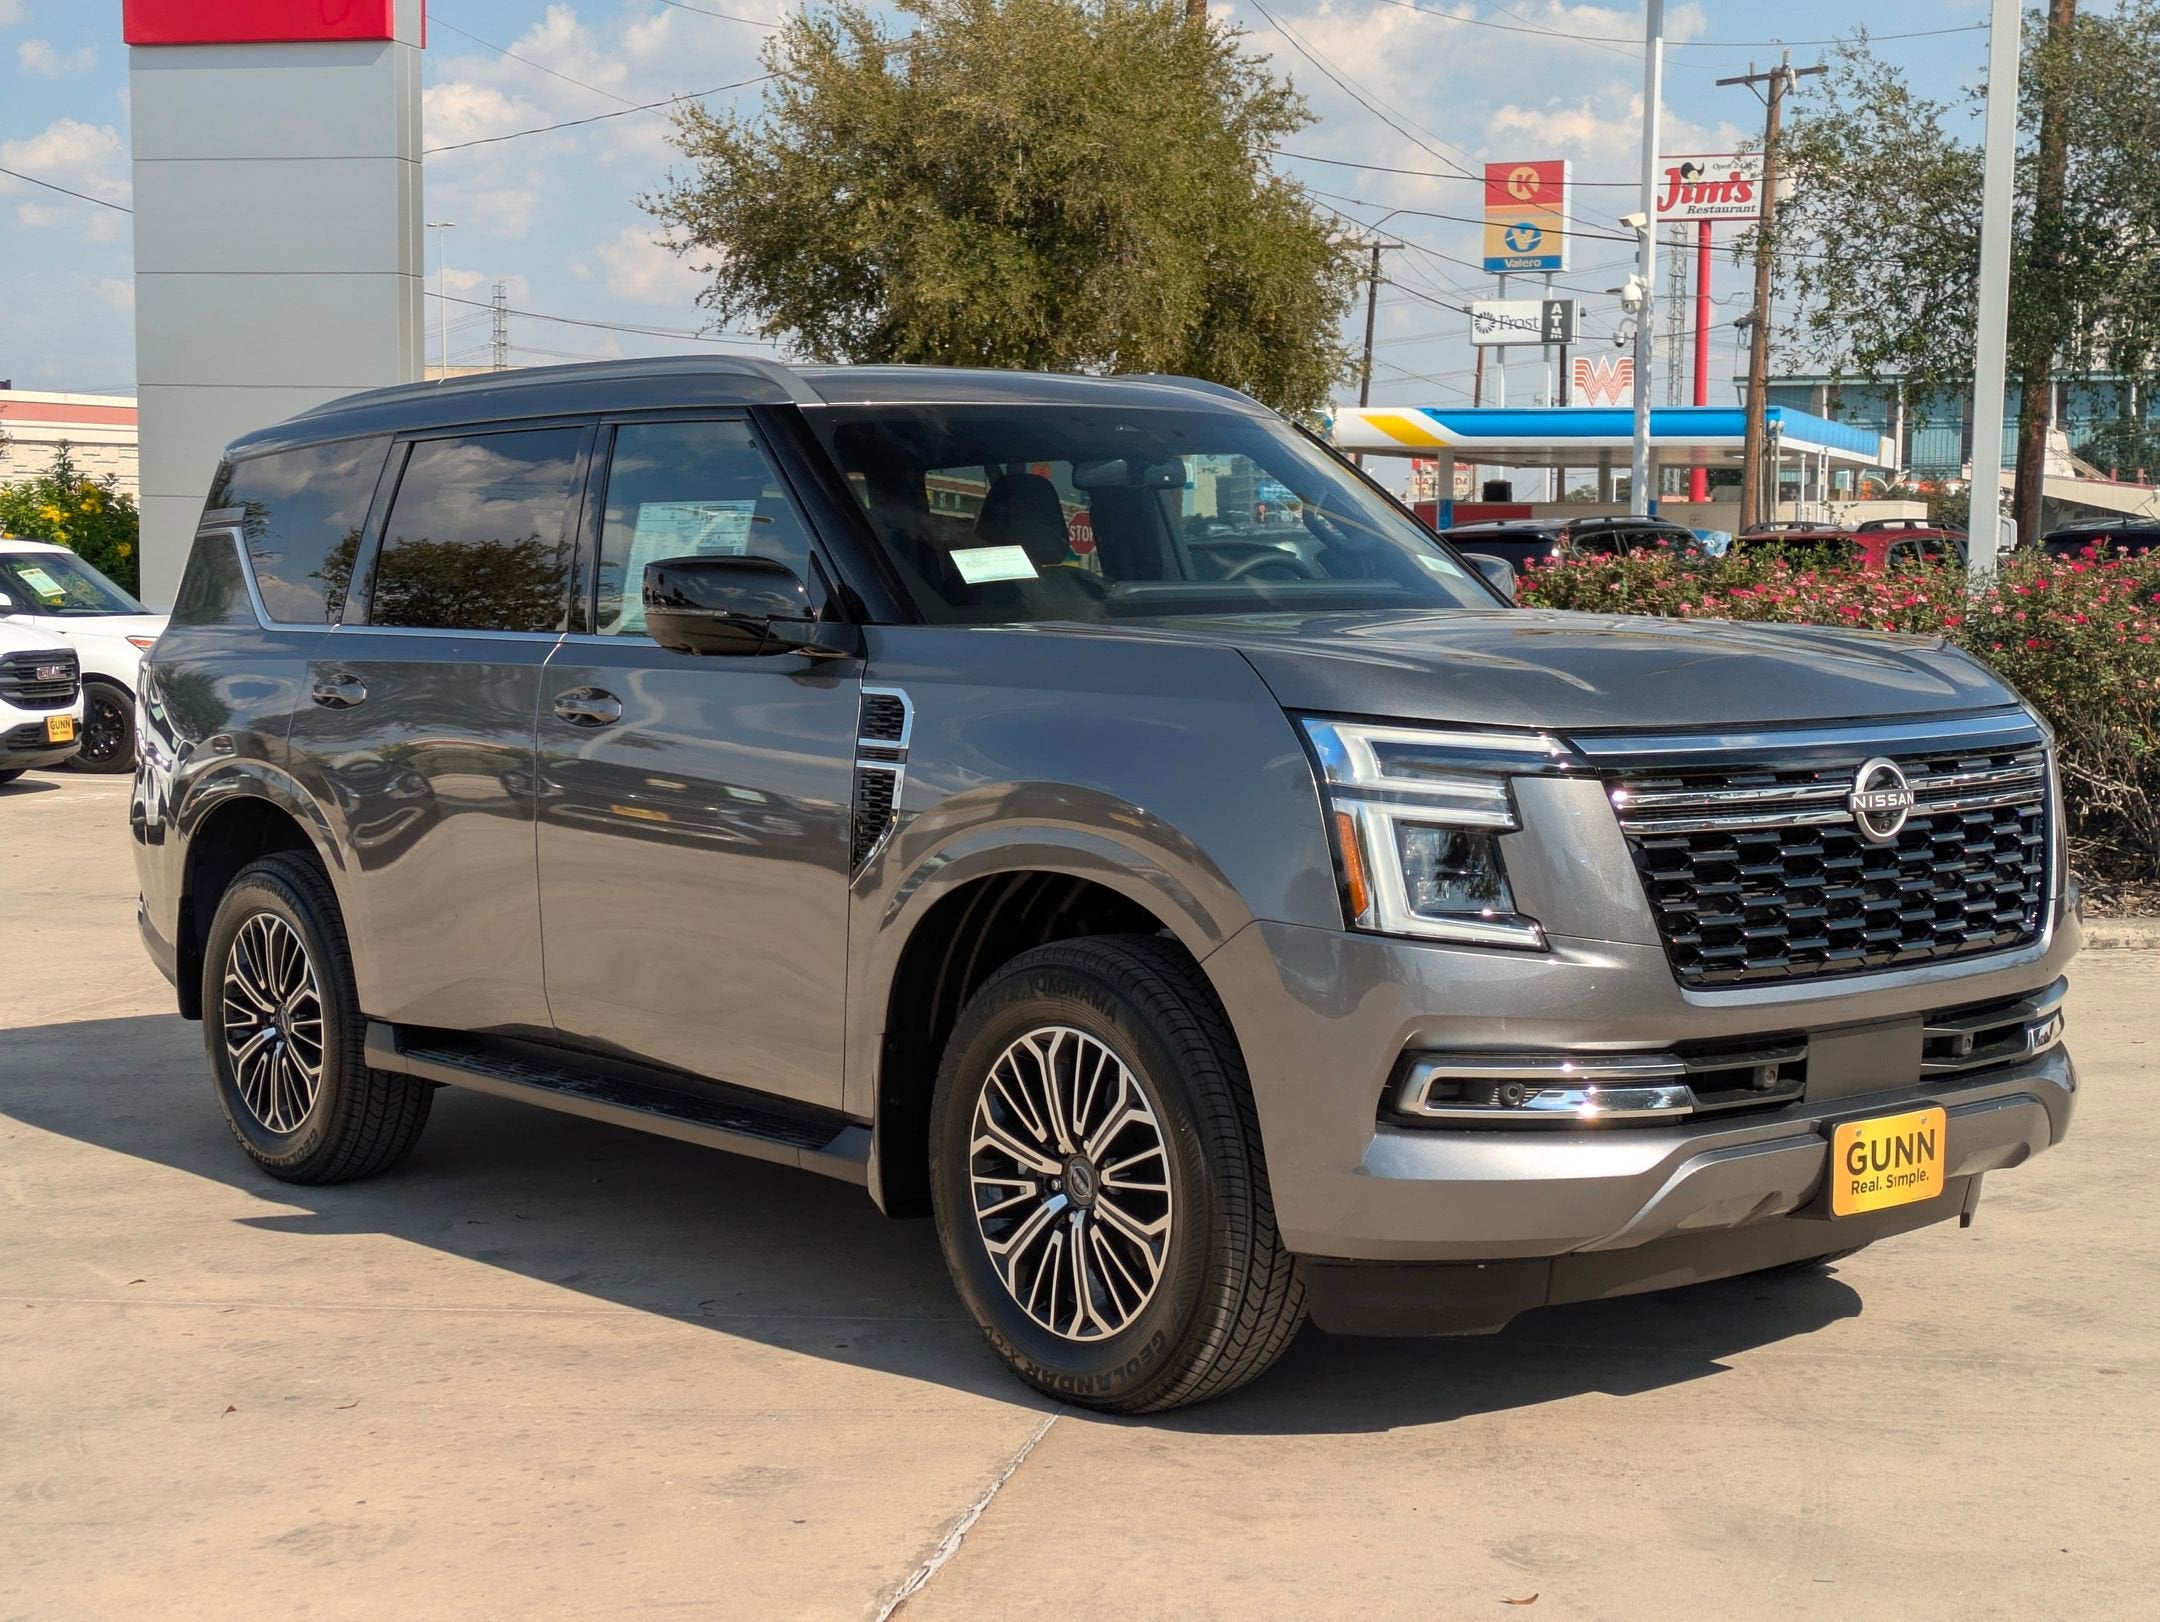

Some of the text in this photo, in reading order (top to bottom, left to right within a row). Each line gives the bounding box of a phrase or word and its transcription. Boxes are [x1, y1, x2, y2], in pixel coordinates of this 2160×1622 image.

[1657, 167, 1754, 212] Jim's
[1687, 205, 1756, 214] Restaurant
[1504, 258, 1542, 268] Valero
[1499, 314, 1540, 330] Frost
[1550, 302, 1563, 339] ATM
[50, 720, 70, 730] GUNN
[1853, 791, 1914, 809] NISSAN
[1027, 974, 1118, 1023] YOKOHAMA
[1846, 1129, 1935, 1176] GUNN
[1851, 1176, 1882, 1195] Real.
